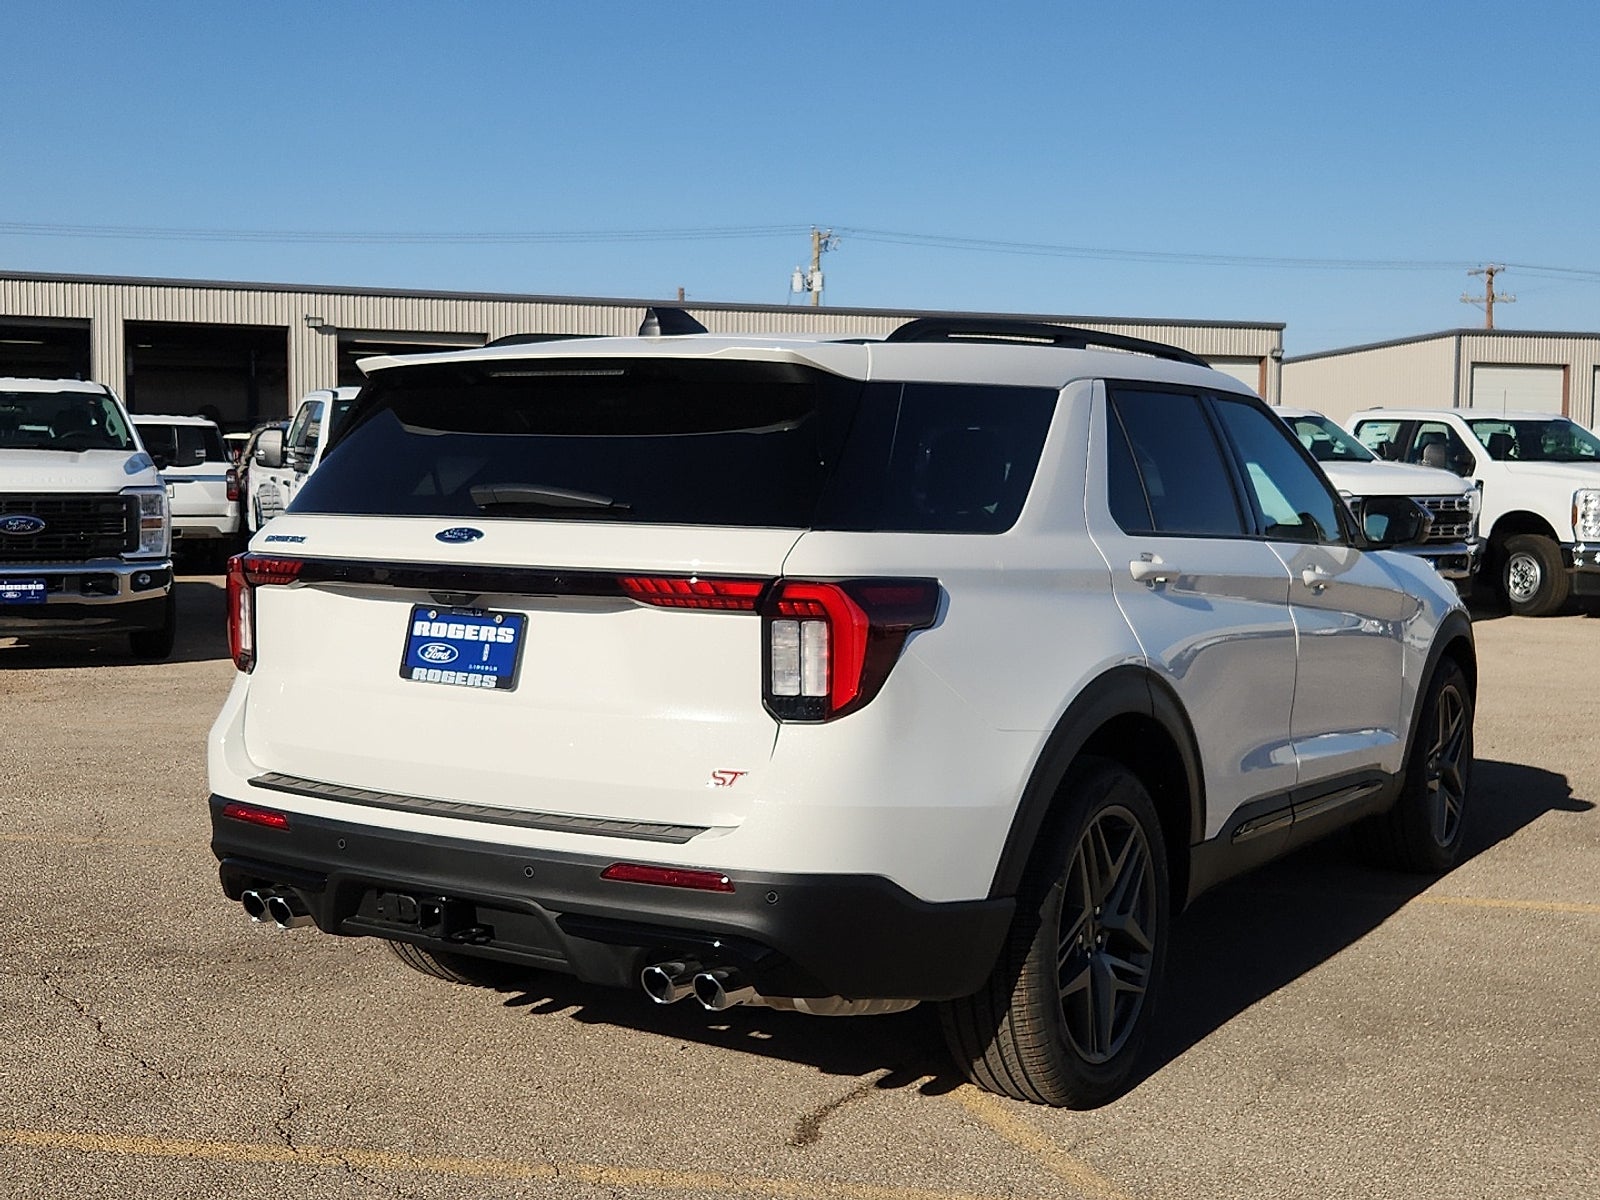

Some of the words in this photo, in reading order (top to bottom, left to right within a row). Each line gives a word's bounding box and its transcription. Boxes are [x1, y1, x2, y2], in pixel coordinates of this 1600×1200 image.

[413, 621, 515, 643] ROGERS
[424, 645, 452, 660] Ford
[468, 663, 498, 672] LINCOLN
[412, 667, 497, 687] ROGERS
[706, 769, 749, 787] ST
